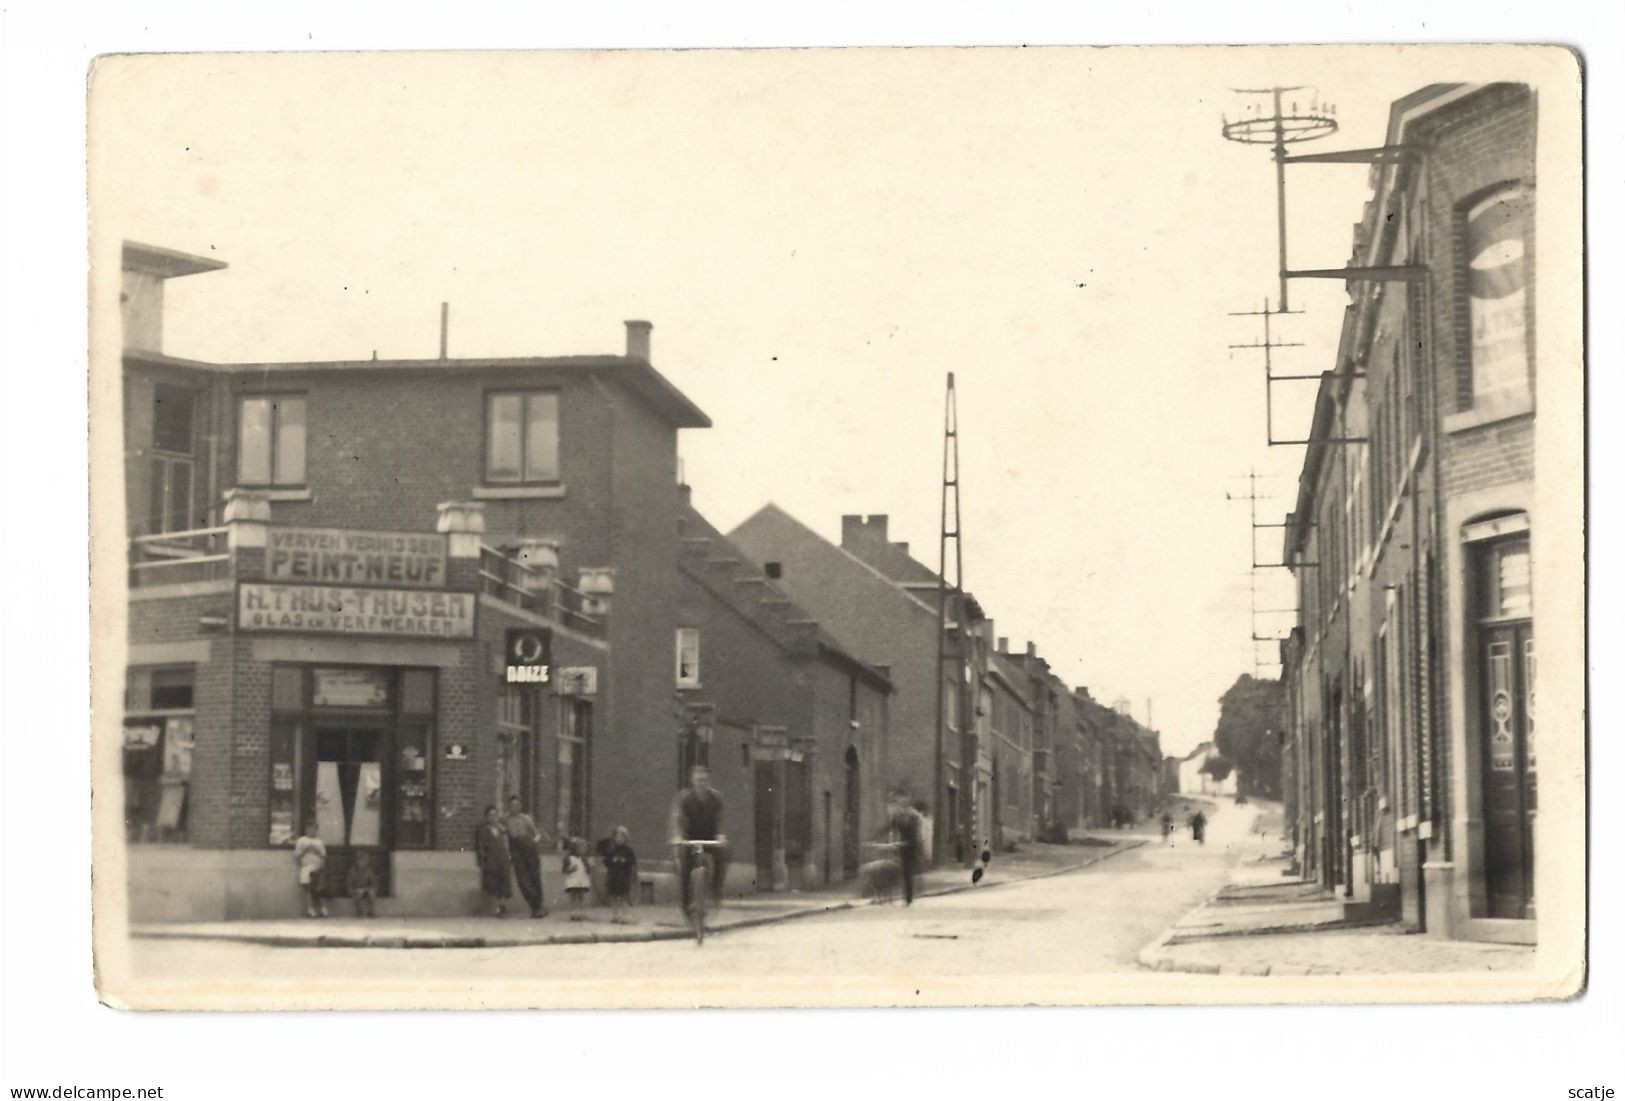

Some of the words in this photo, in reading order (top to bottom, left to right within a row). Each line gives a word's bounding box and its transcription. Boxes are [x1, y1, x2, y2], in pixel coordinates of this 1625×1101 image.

[271, 532, 340, 550] VERVEN
[345, 535, 442, 554] VERNISSEN
[253, 613, 303, 627] GLAS
[329, 615, 453, 634] VERFWERKEN
